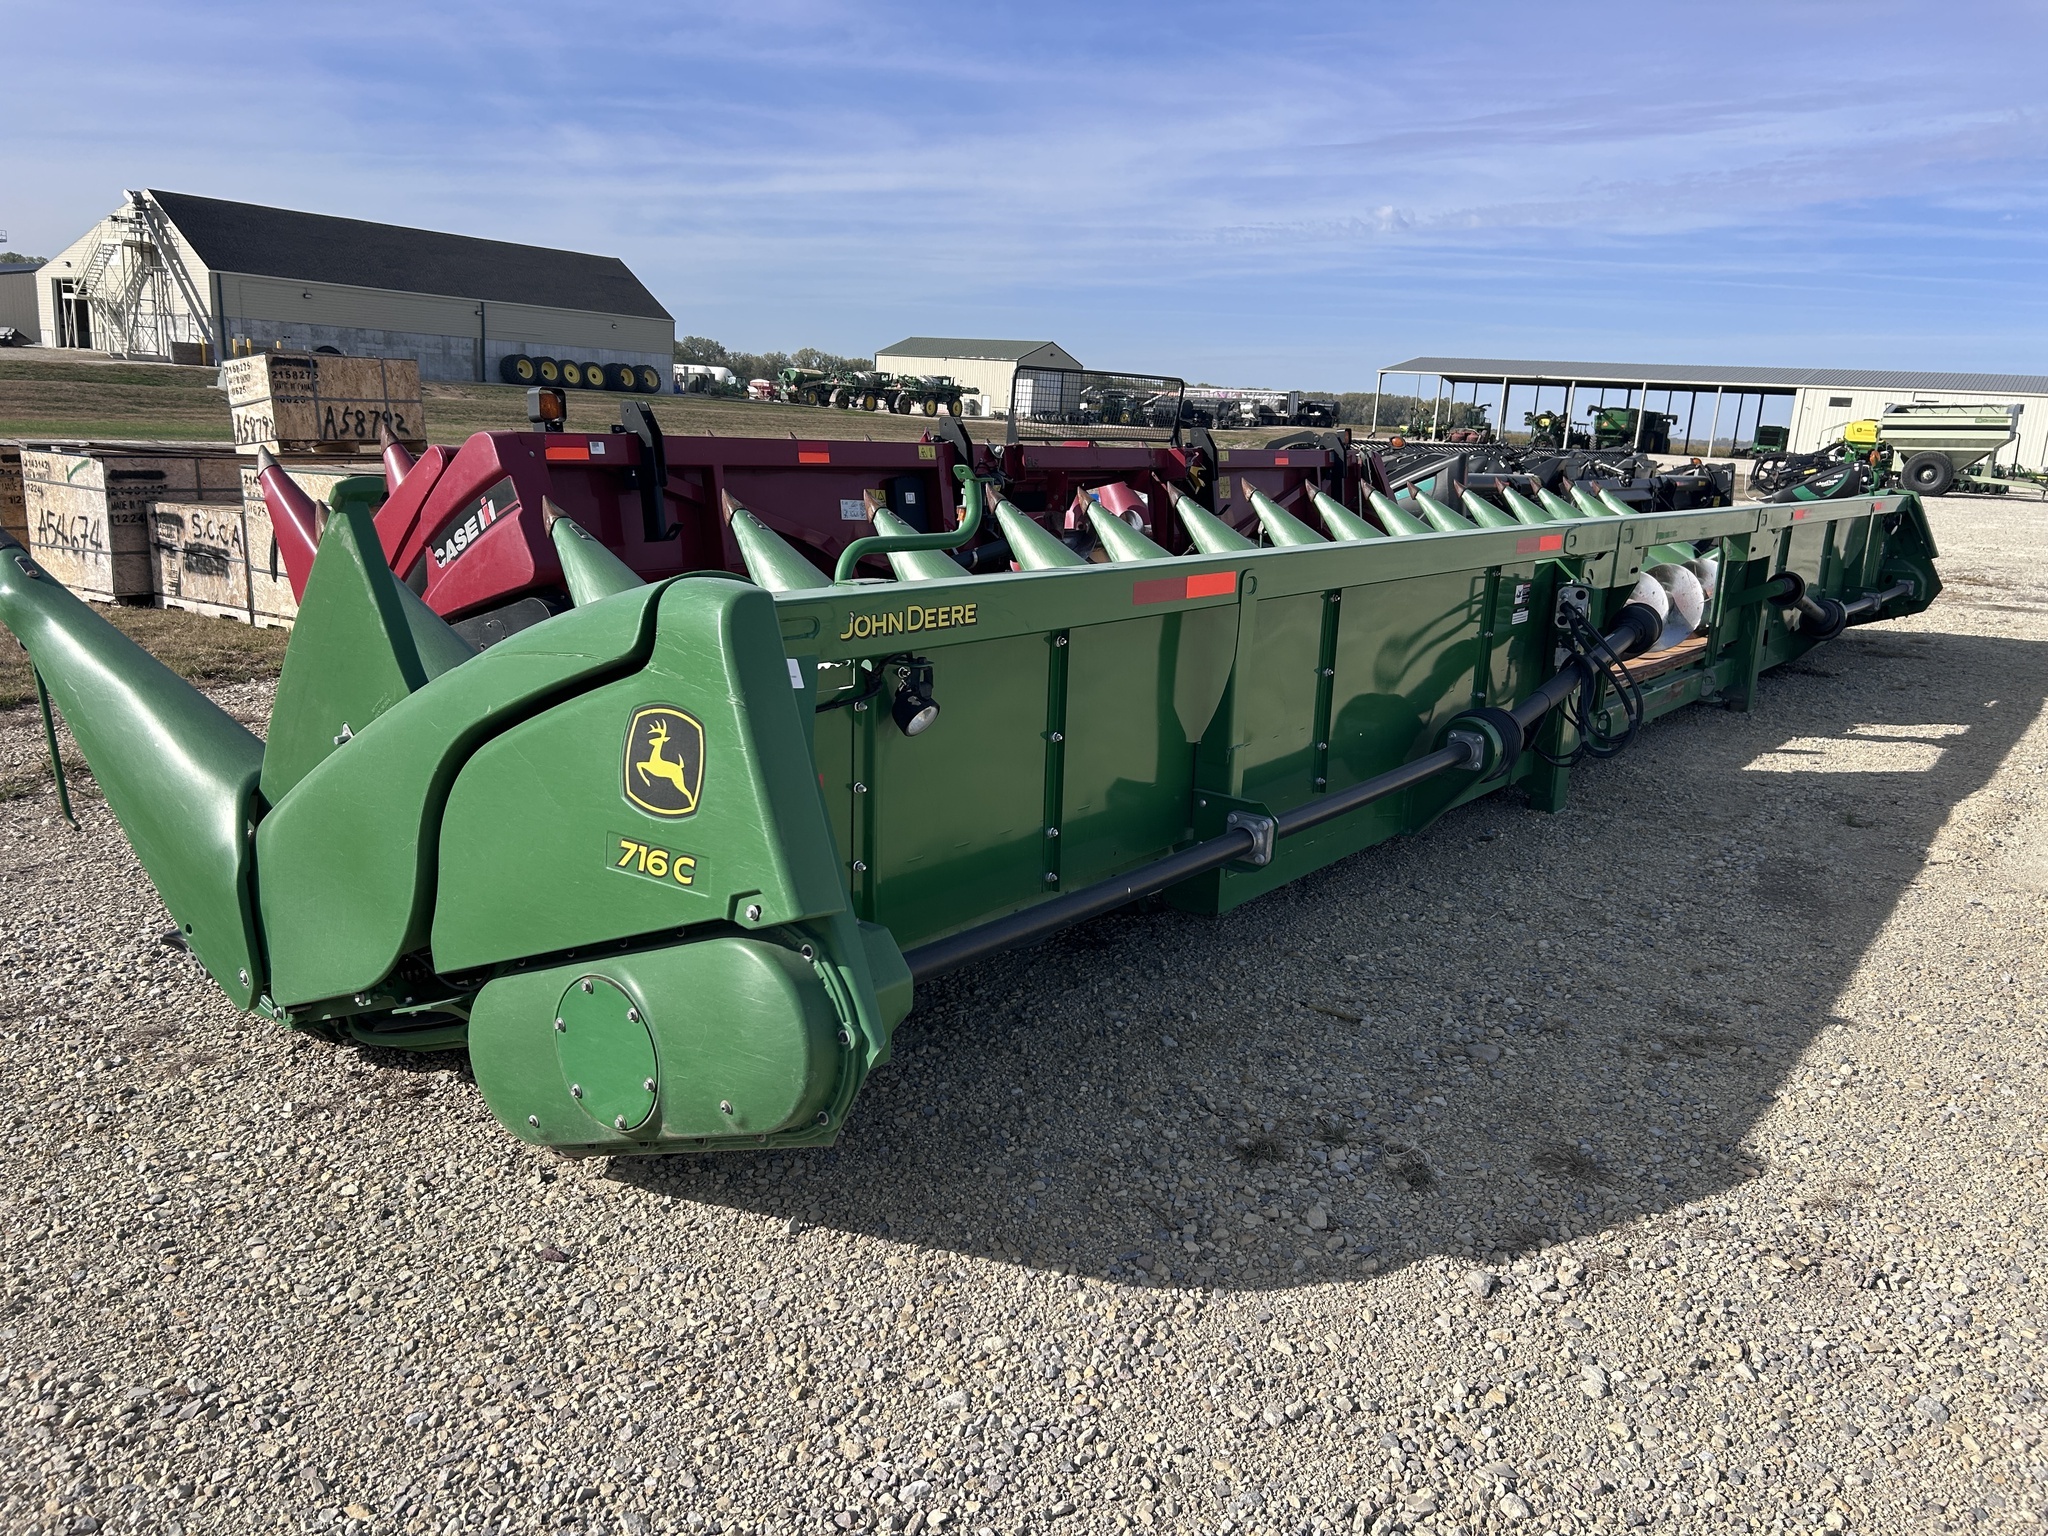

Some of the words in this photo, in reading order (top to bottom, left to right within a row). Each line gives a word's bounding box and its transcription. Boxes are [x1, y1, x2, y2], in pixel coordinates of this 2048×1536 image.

[271, 370, 319, 380] 2158275
[235, 414, 277, 443] A58792
[323, 405, 411, 440] A58792
[38, 507, 103, 565] A54674
[434, 515, 480, 569] CASE
[840, 611, 904, 641] JOHN
[905, 603, 979, 633] DEERE
[615, 838, 671, 878] 716
[672, 854, 698, 887] C
